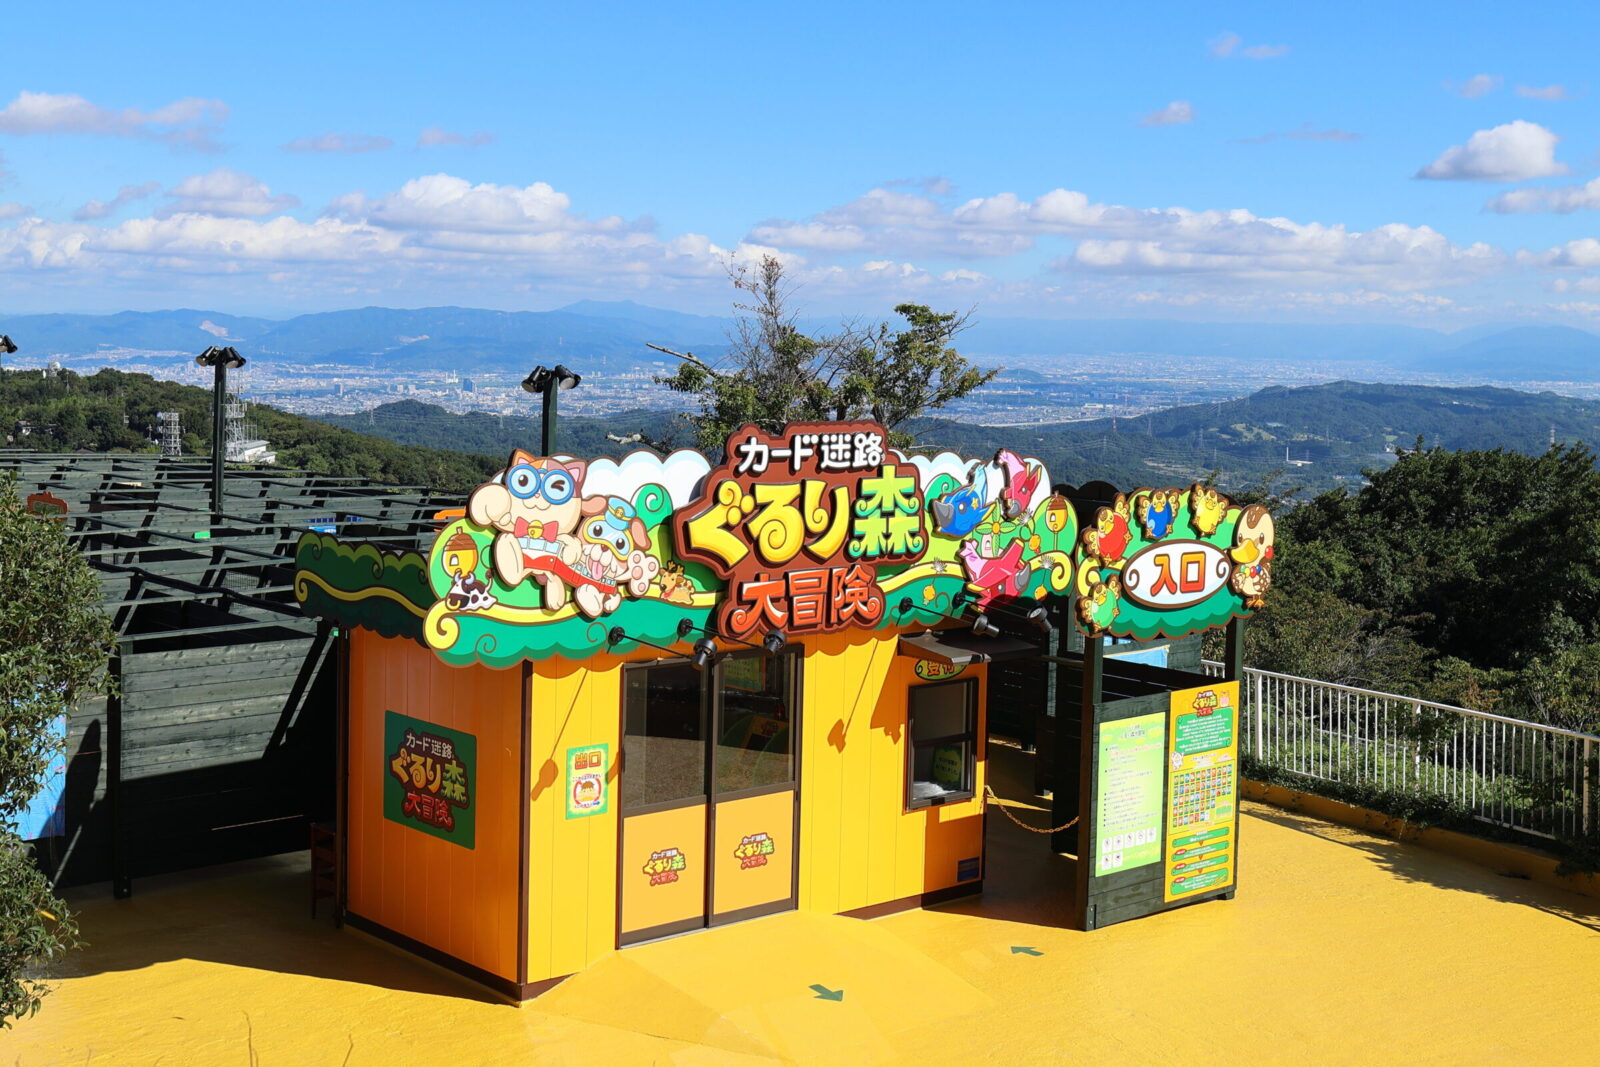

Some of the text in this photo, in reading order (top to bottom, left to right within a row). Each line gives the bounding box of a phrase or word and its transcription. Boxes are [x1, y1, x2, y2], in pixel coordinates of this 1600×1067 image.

[738, 433, 883, 473] カード迷路
[687, 465, 924, 568] ぐるり森
[1150, 551, 1206, 597] 入口
[730, 564, 882, 634] 大冒険
[405, 733, 453, 760] カード迷路
[574, 751, 602, 770] 出口
[391, 748, 467, 803] ぐるり森
[404, 791, 452, 827] 大冒険
